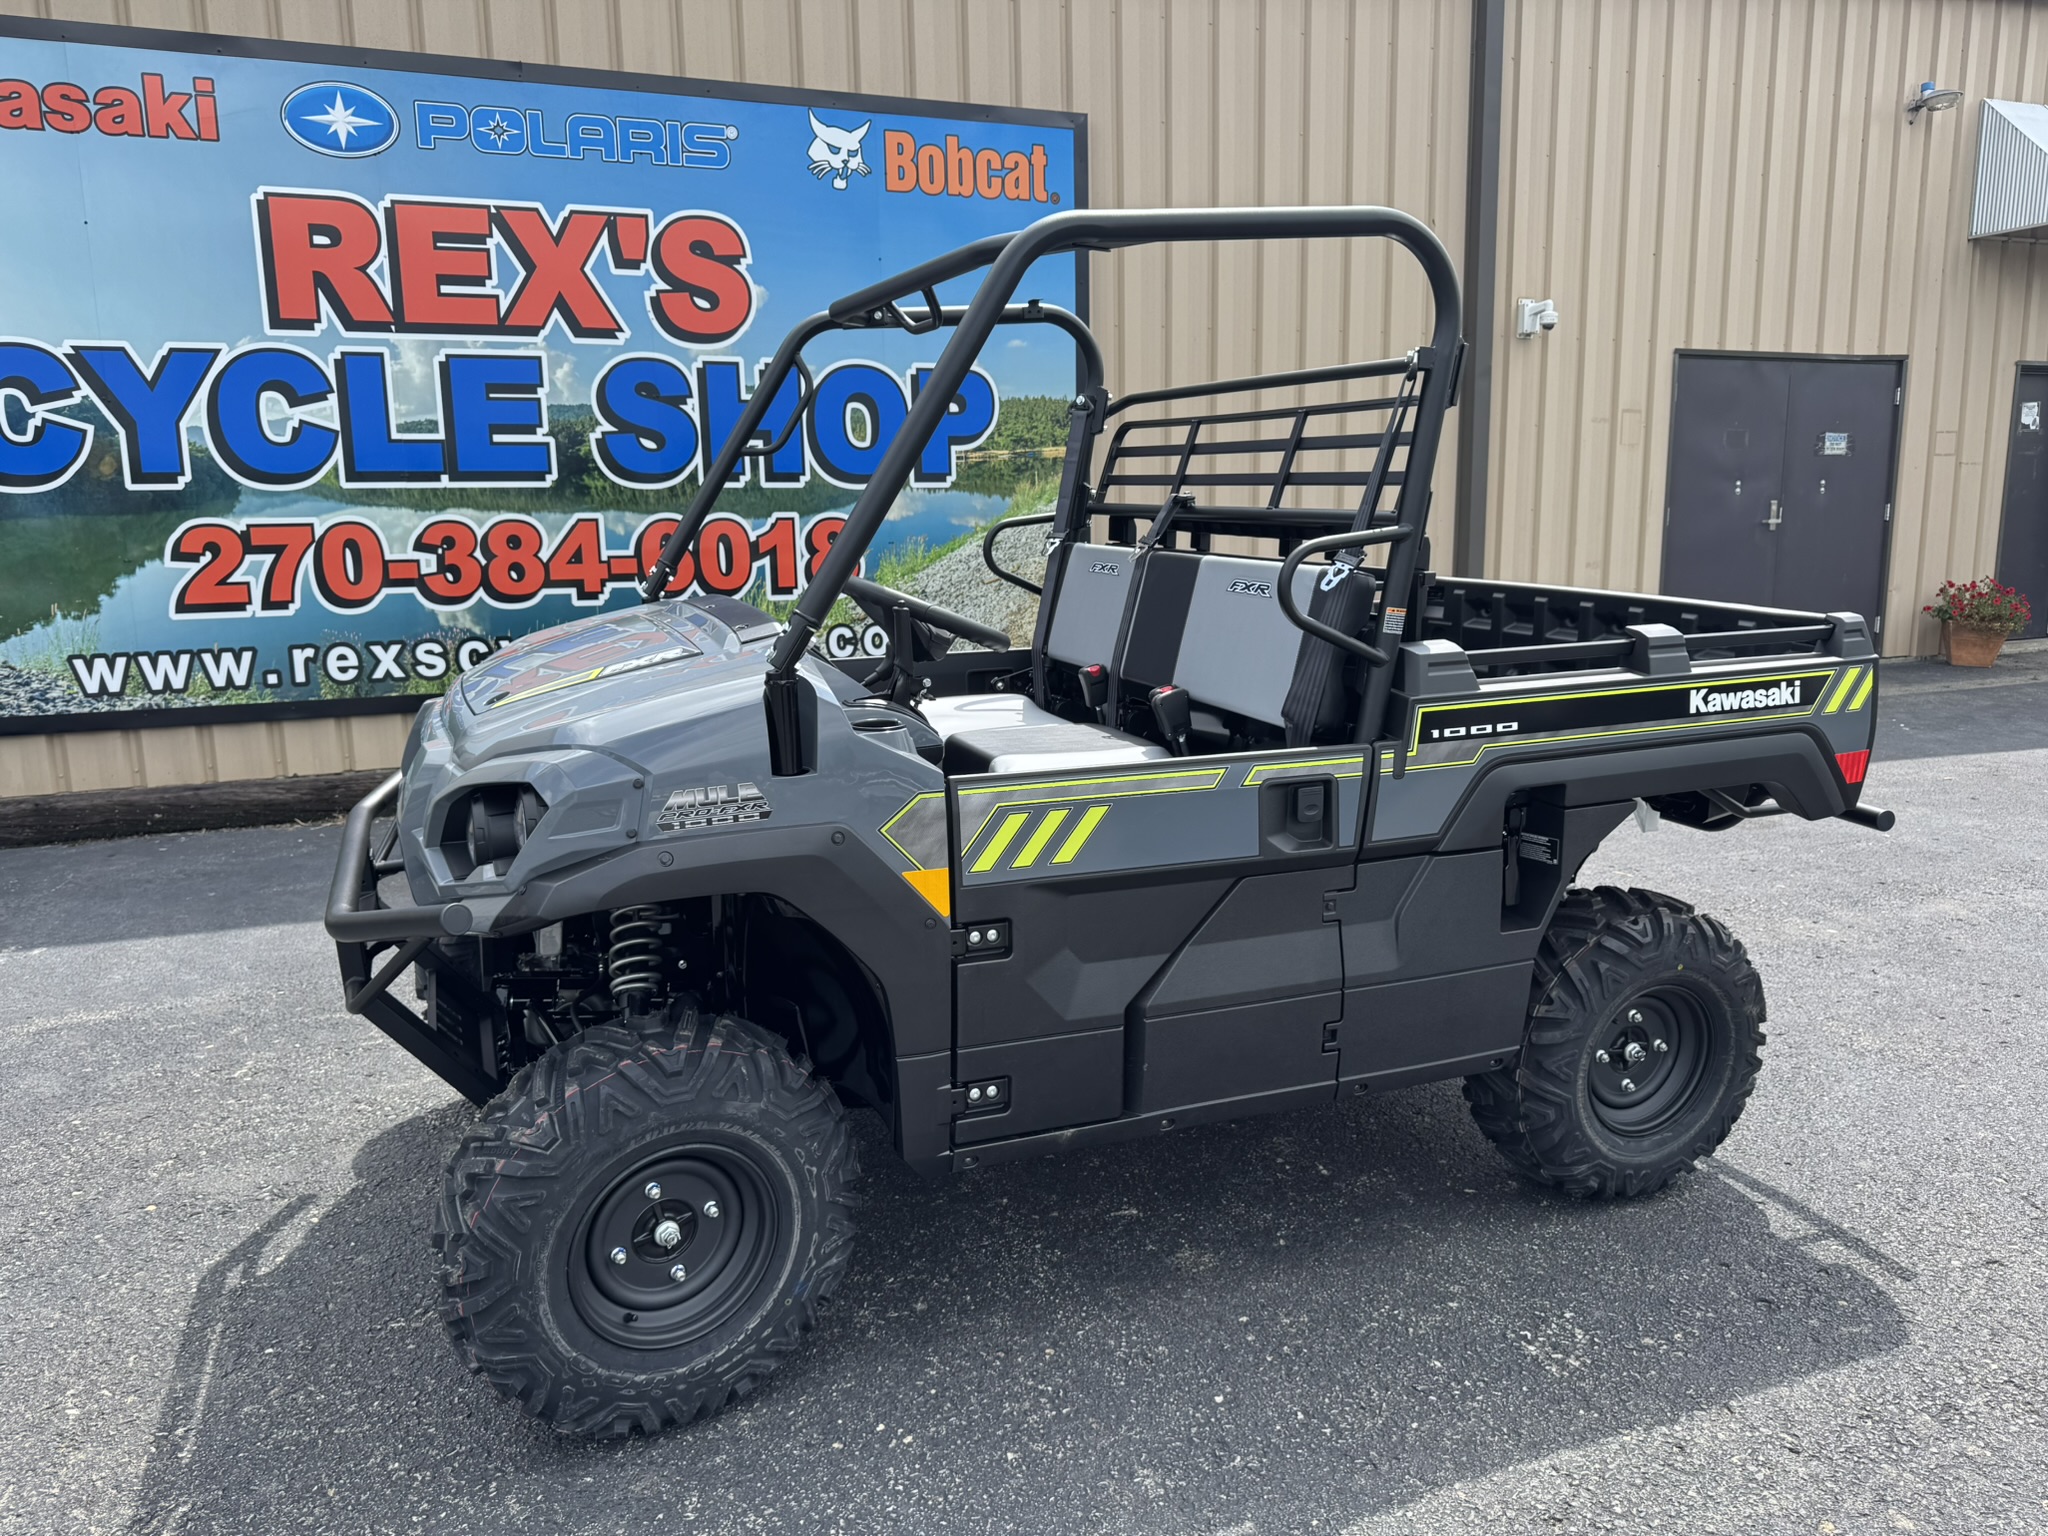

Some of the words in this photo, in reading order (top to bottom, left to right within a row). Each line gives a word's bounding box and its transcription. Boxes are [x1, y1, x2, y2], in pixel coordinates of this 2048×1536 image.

[414, 100, 732, 168] POLARIS
[884, 130, 1049, 203] Bobcat
[256, 191, 751, 342] REX'S
[0, 344, 553, 488] CYCLE
[594, 353, 996, 485] SHOP
[1089, 562, 1119, 576] FXR
[1227, 579, 1272, 598] FXR
[1689, 680, 1801, 714] Kawasaki
[1430, 721, 1519, 739] 1000
[662, 782, 768, 812] MULE
